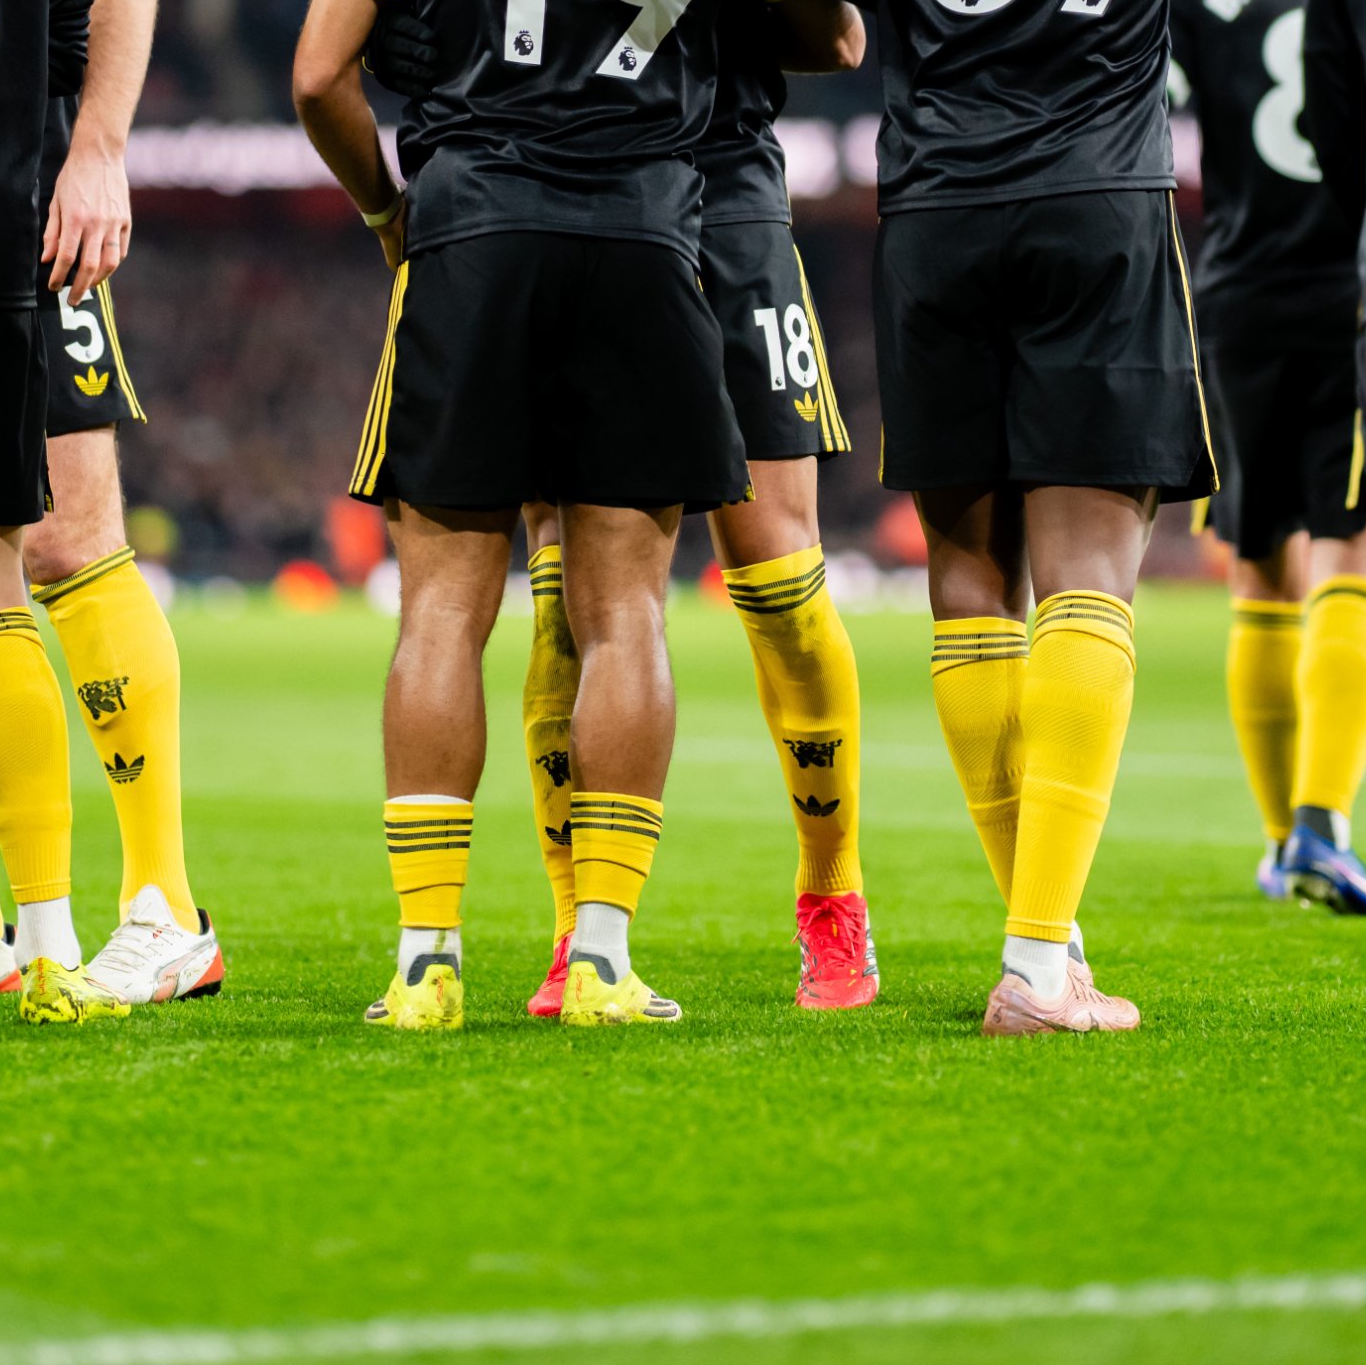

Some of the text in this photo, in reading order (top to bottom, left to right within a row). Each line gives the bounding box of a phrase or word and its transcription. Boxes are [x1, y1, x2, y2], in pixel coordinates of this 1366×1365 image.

[1252, 7, 1323, 183] 8
[58, 285, 104, 363] 5
[753, 303, 819, 391] 18
